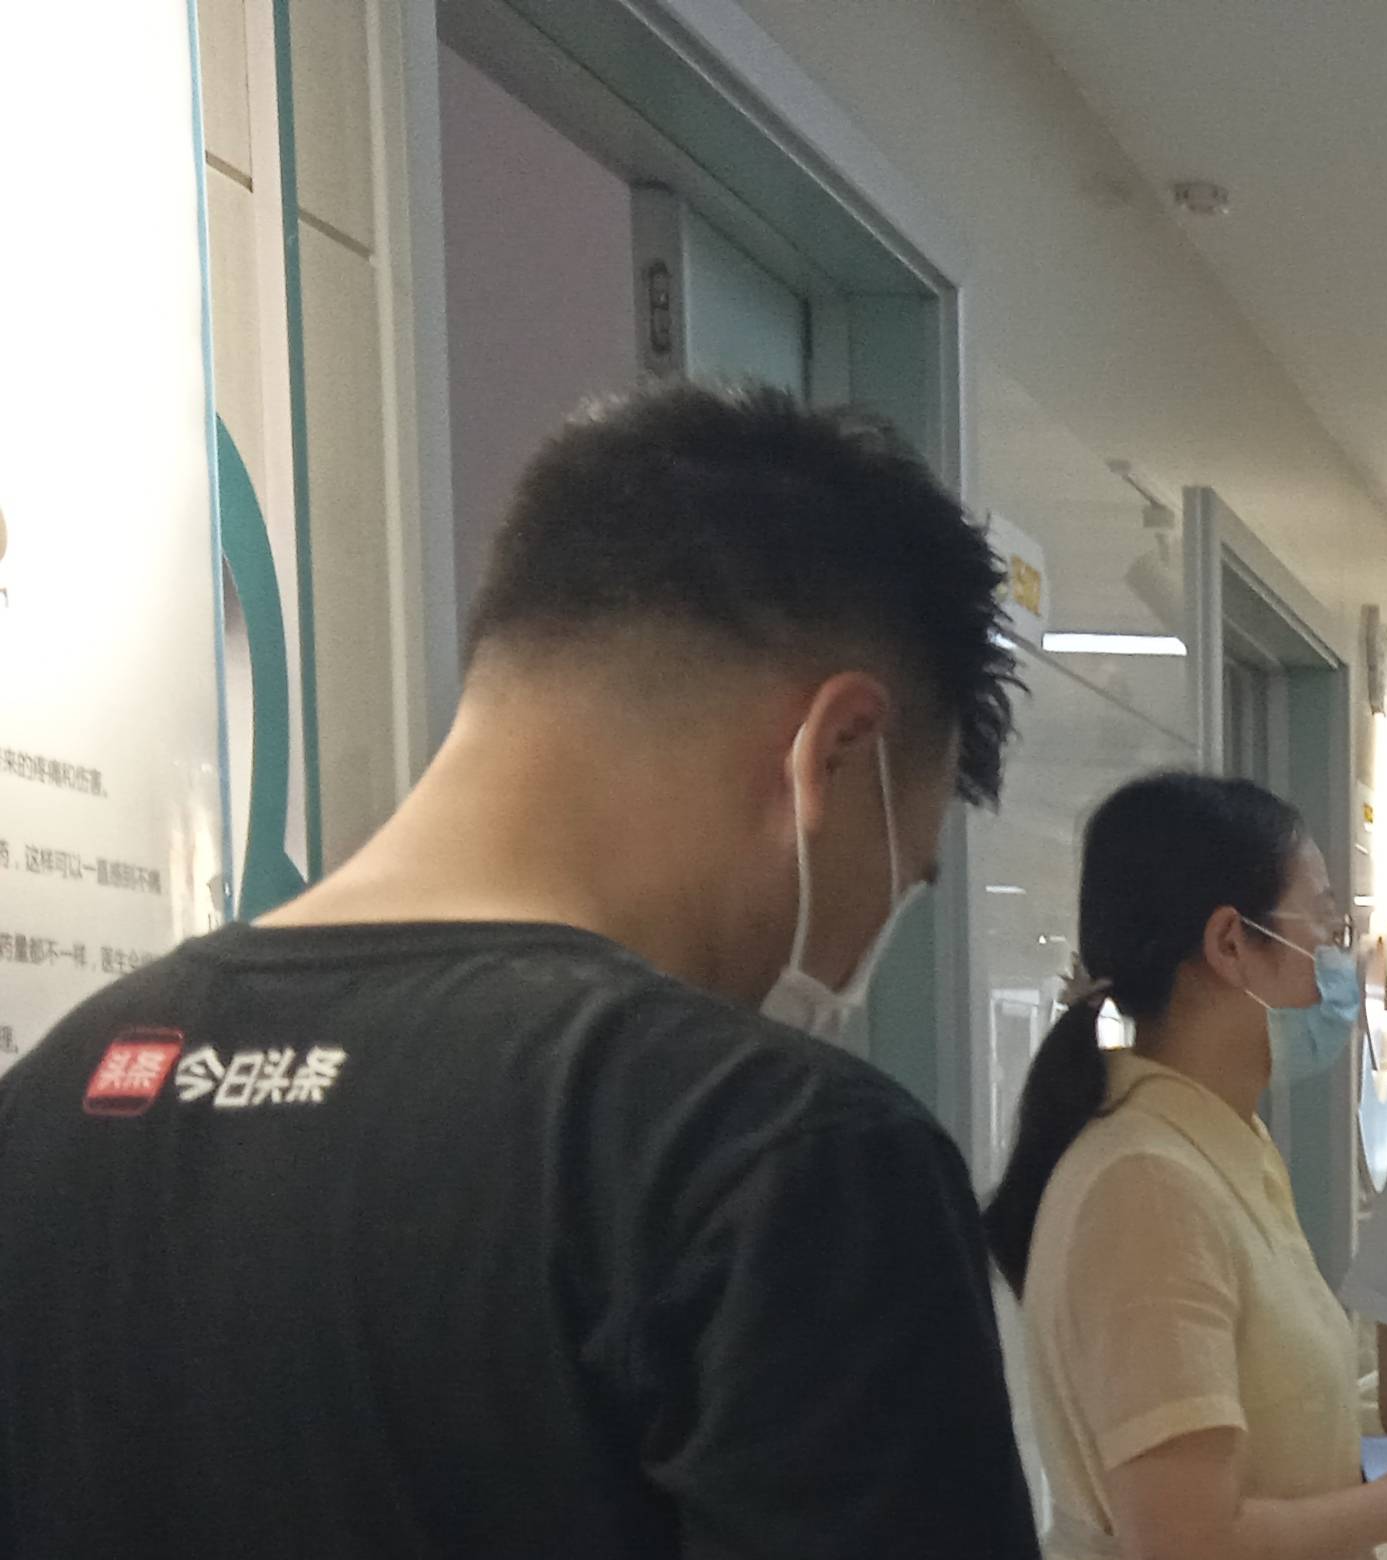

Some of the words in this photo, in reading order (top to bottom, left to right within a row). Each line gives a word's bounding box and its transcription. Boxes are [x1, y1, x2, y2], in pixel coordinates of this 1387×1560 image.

[95, 1048, 166, 1091] 头条
[173, 1043, 349, 1108] 今日头条
